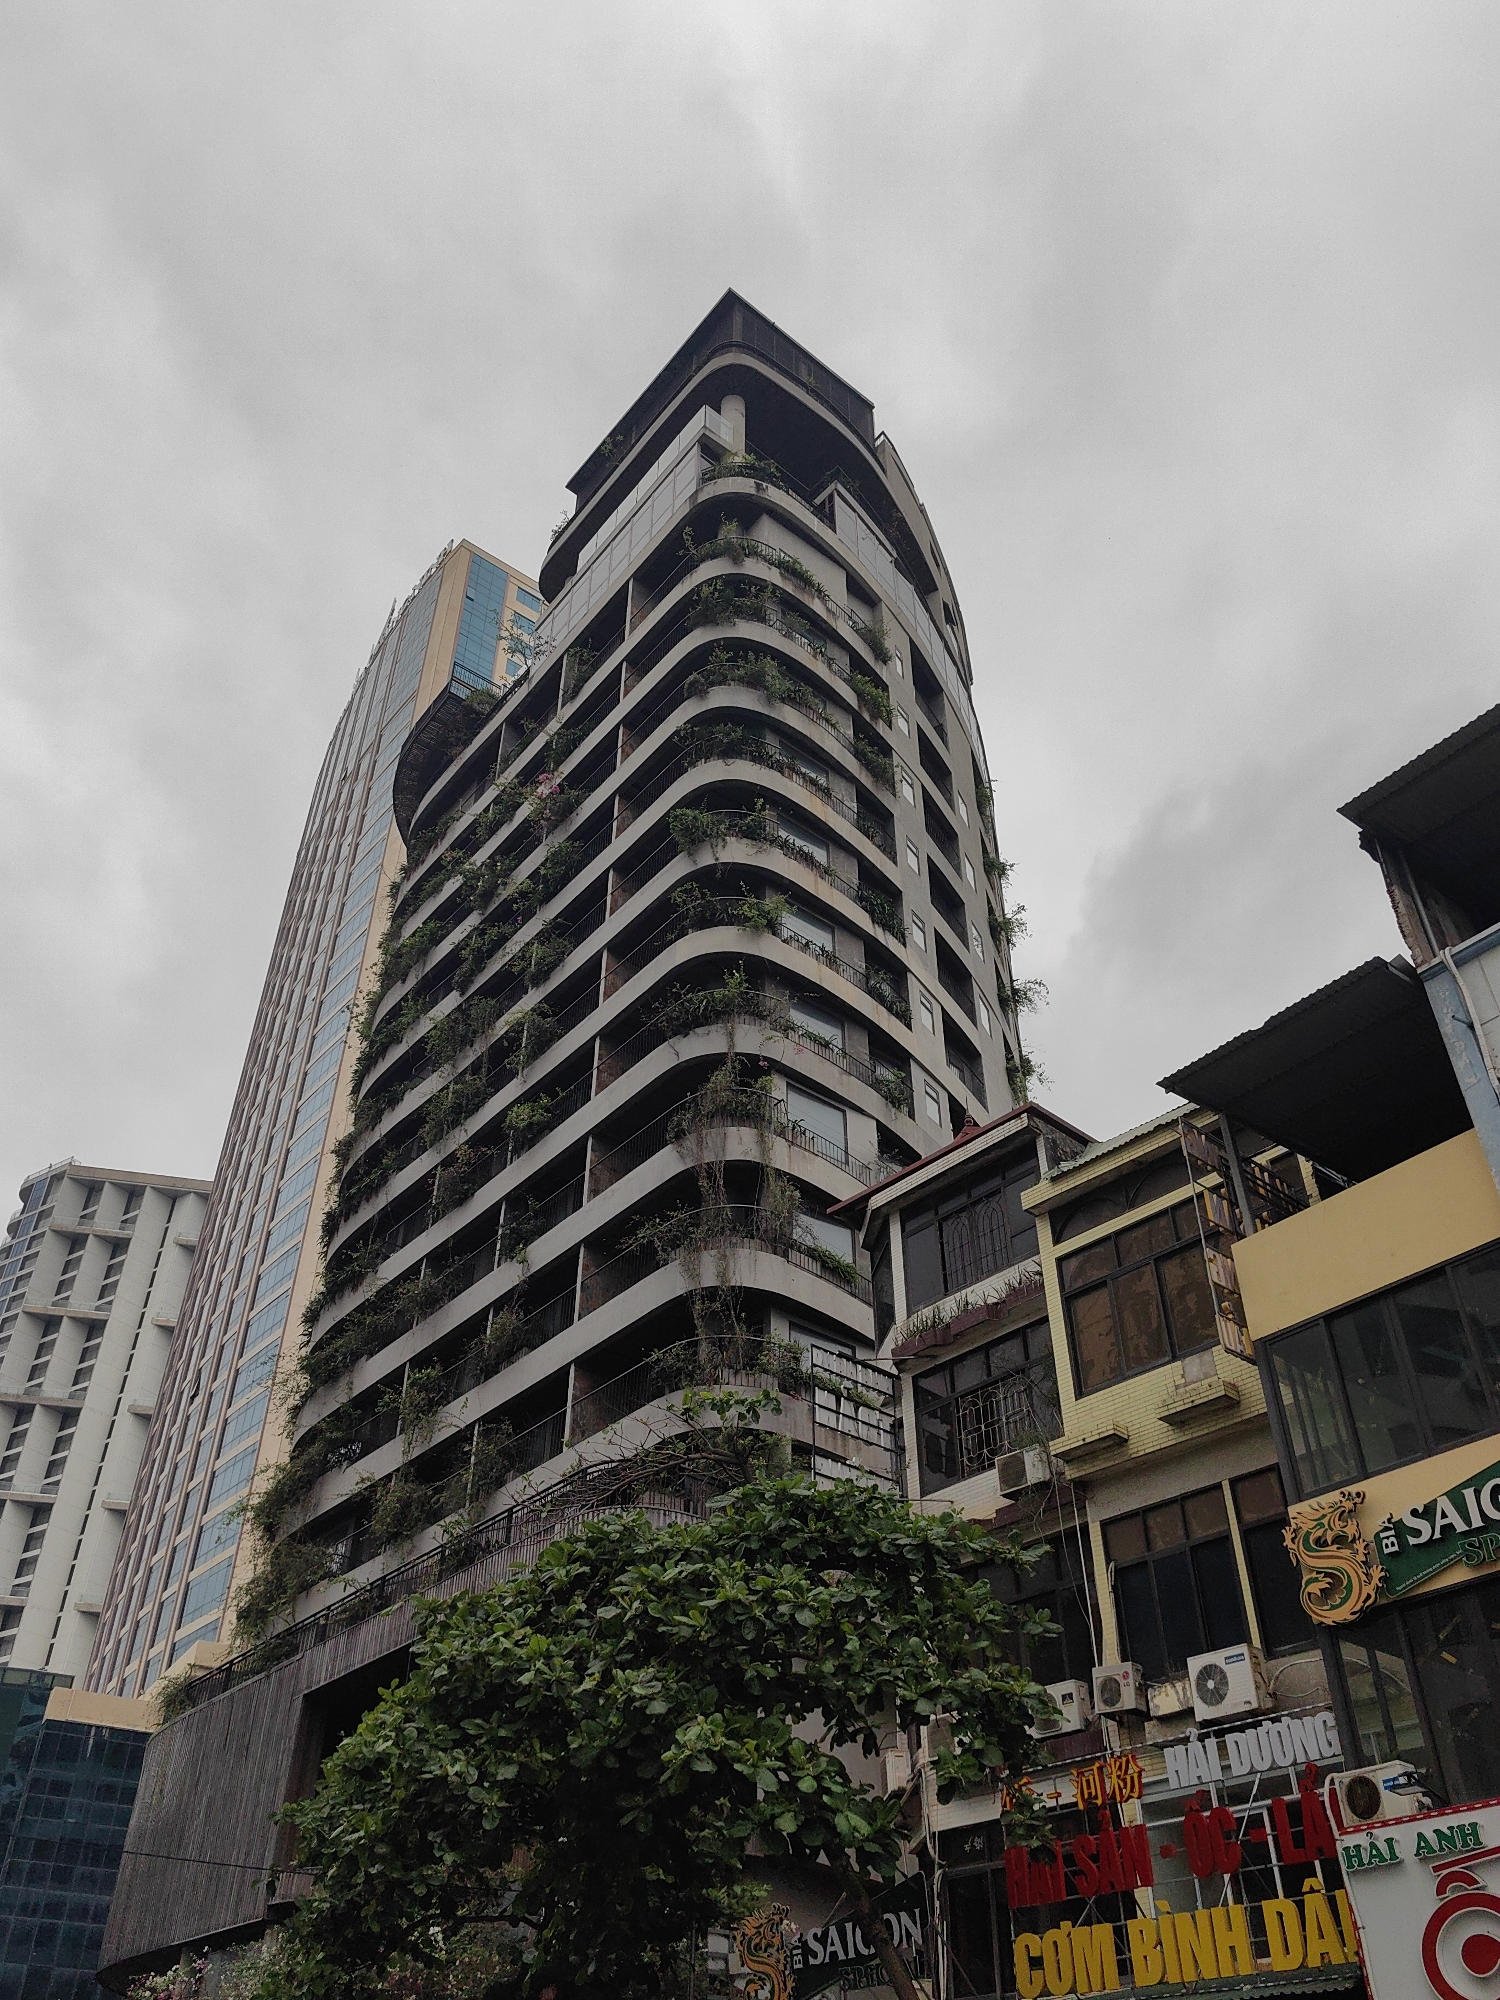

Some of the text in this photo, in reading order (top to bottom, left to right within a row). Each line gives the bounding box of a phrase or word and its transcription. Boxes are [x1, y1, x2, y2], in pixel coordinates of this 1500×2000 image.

[1377, 1512, 1399, 1555] BIA
[1070, 1754, 1145, 1810] 河粉
[1164, 1712, 1342, 1789] HẢI DƯƠNG
[1072, 1810, 1154, 1897] SẢN
[1271, 1762, 1344, 1865] LẨ
[1342, 1822, 1483, 1870] HẢI ANH
[1014, 1921, 1120, 1999] CƠM
[1127, 1900, 1251, 1987] BÌNH
